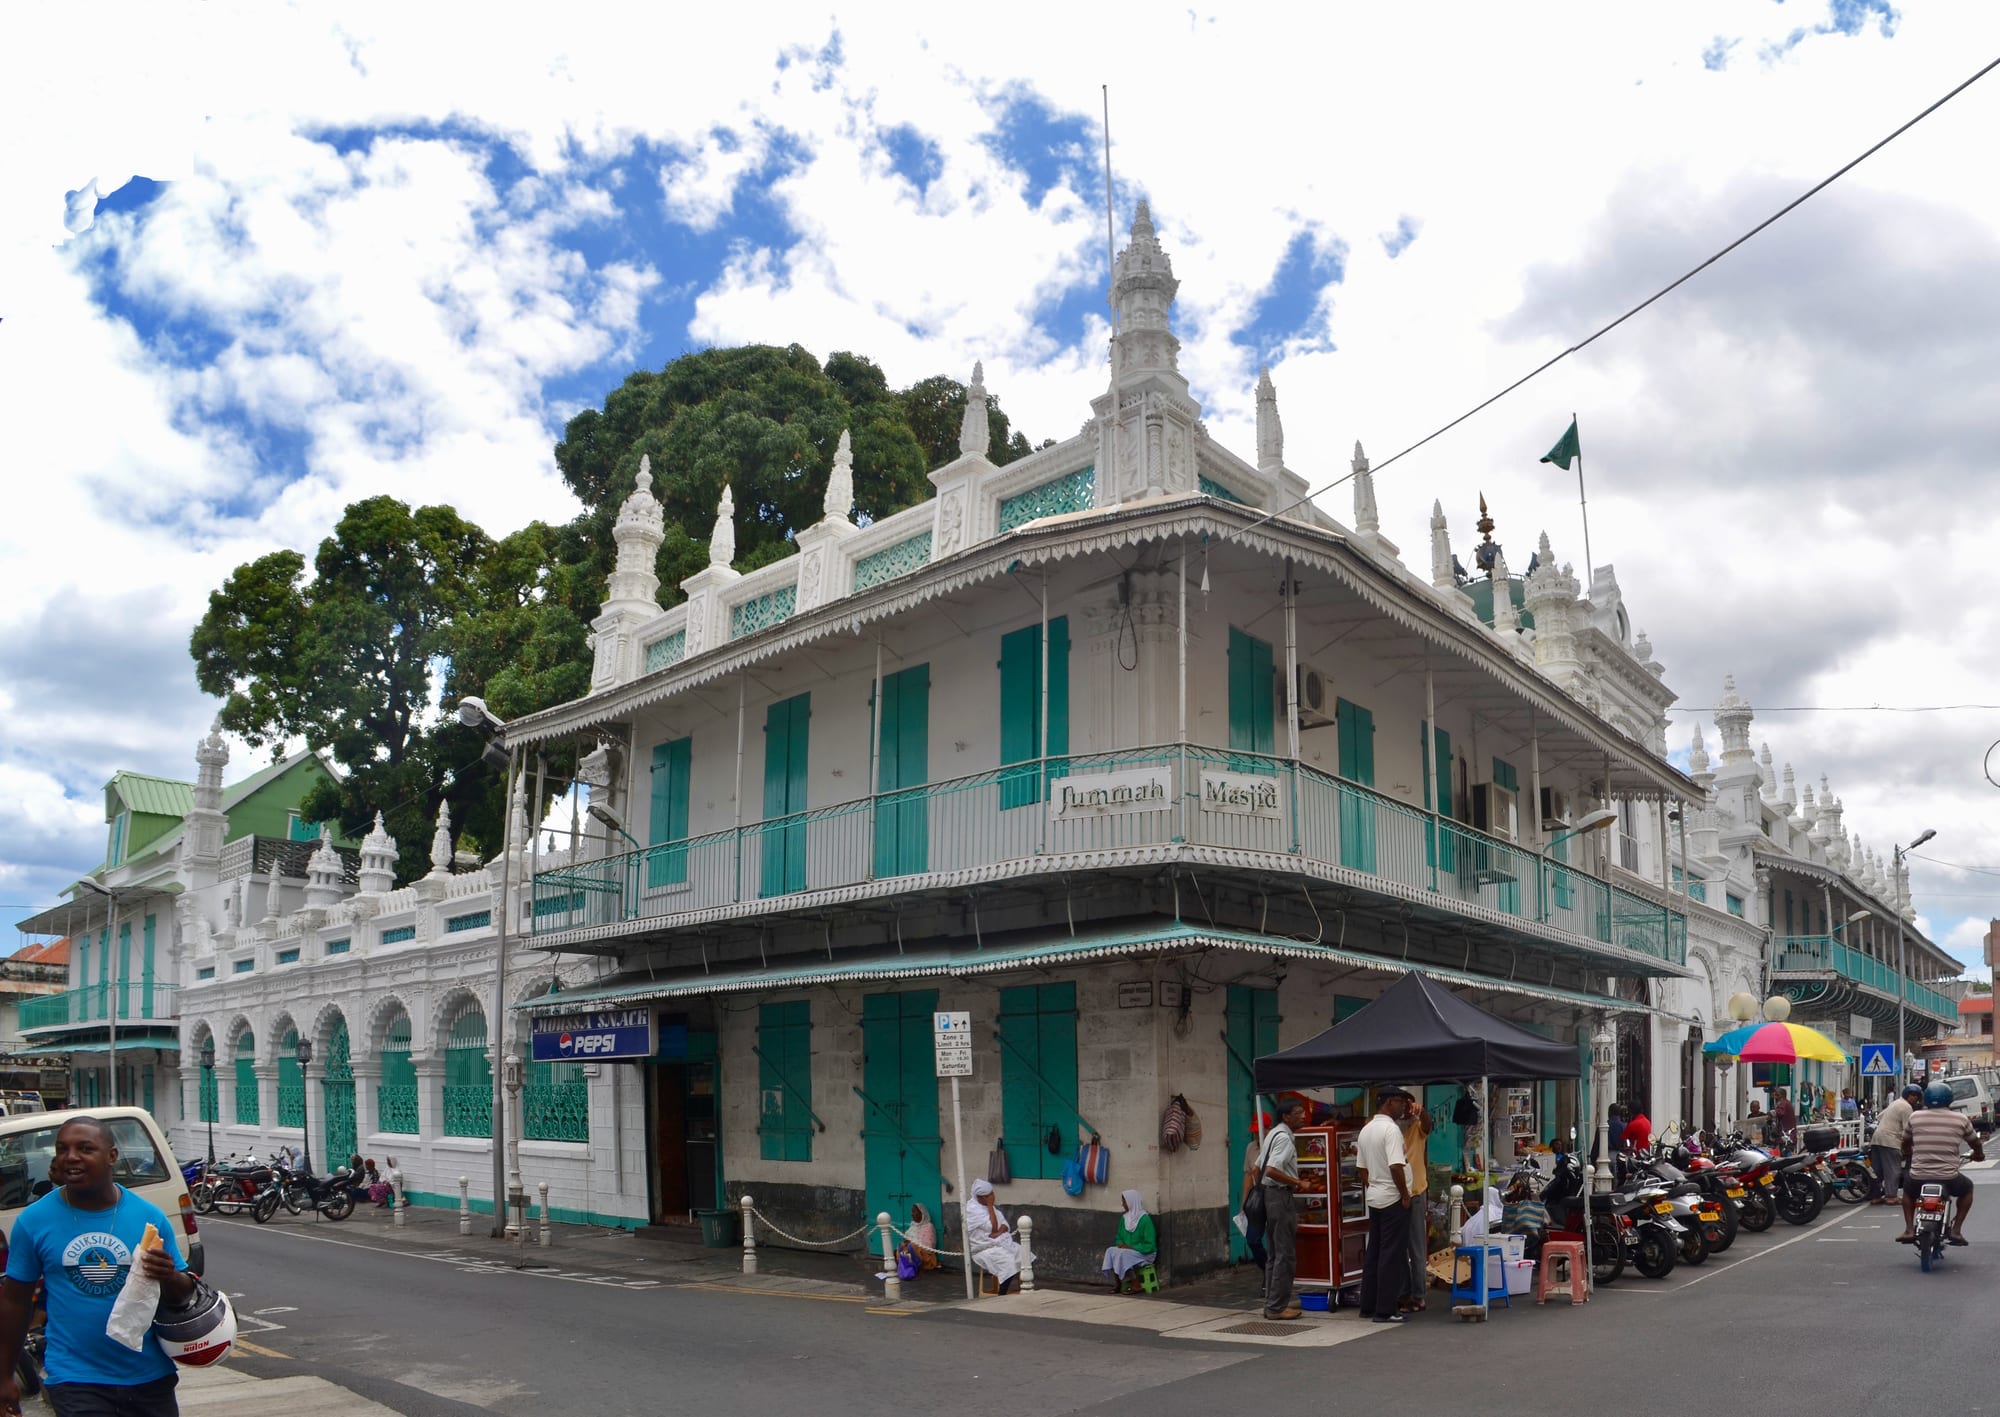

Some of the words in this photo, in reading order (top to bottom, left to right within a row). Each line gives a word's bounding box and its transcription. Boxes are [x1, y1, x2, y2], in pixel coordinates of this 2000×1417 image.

[1059, 778, 1165, 815] Jummah
[1205, 779, 1278, 813] Masjid
[597, 1009, 647, 1028] SNACK
[574, 1033, 616, 1055] PEPSI
[66, 1235, 127, 1259] QUIKSILVER
[69, 1269, 128, 1296] FOUNDATION
